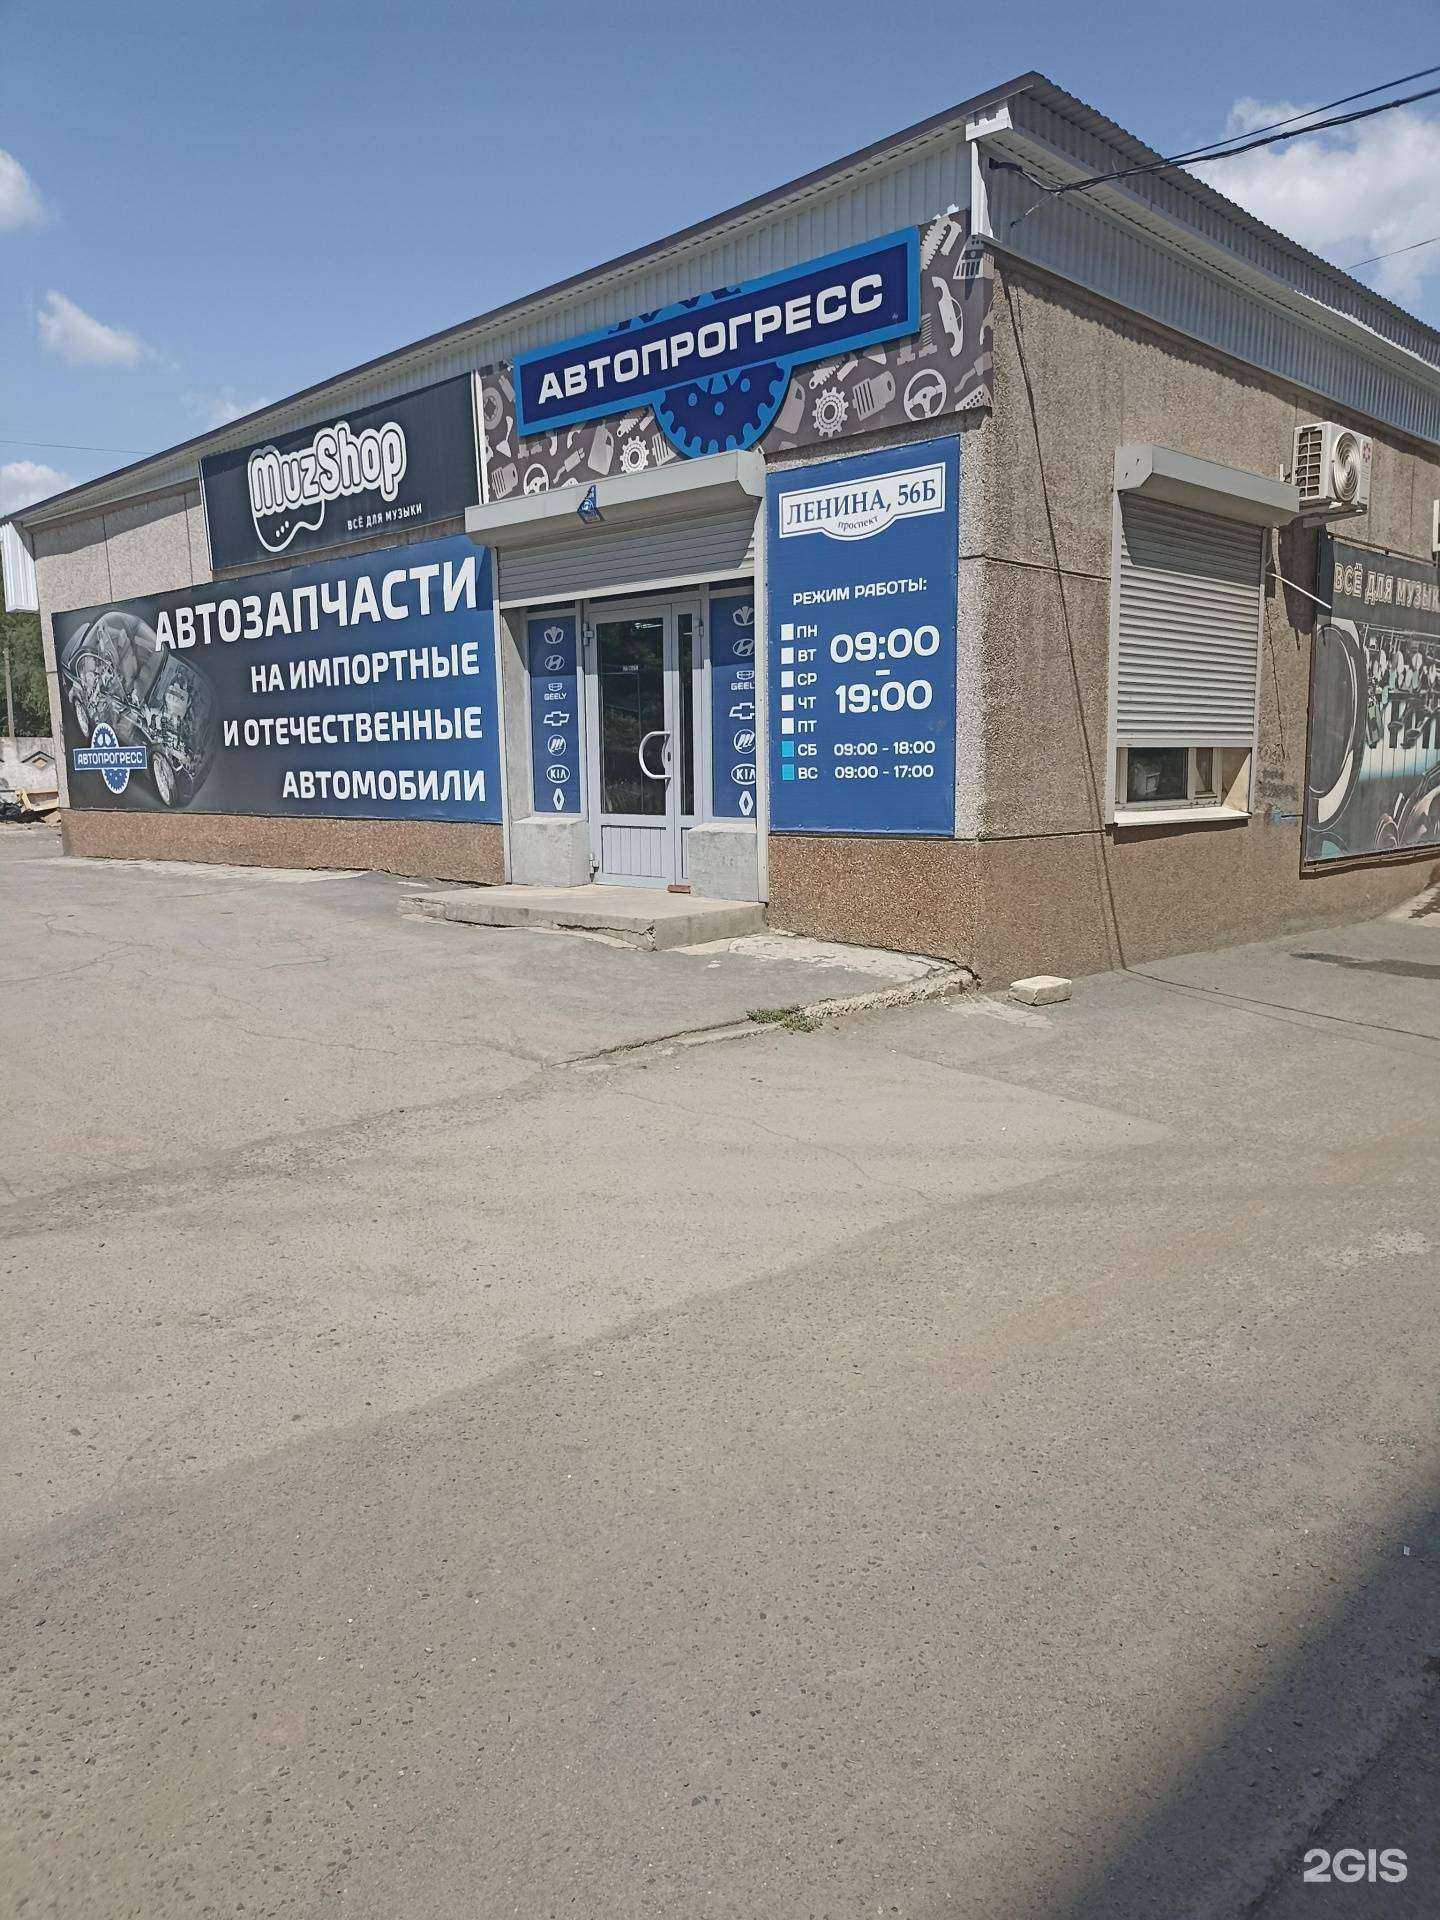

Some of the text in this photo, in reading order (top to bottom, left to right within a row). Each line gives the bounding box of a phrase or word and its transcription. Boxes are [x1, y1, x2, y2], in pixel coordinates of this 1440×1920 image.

[537, 273, 884, 405] АВТОПРОГРЕСС
[248, 420, 407, 518] MuzShop
[786, 478, 936, 526] ЛЕНИНА, 56Б
[347, 502, 422, 531] ВСЁ ДЛЯ МУЗЫКИ
[837, 515, 880, 533] проспект
[793, 577, 928, 606] РЕЖИМ РАБОТЫ:
[1333, 562, 1363, 598] ВСЁ
[1364, 570, 1394, 606] ДЛЯ
[155, 556, 477, 652] АВТОЗАПЧАСТИ
[796, 624, 818, 638] ПН
[797, 648, 817, 662] ВТ
[830, 625, 940, 664] 09:00
[251, 641, 481, 693] НА ИМПОРТНЫЕ
[730, 681, 755, 691] GEEL
[797, 672, 818, 686] СР
[544, 692, 567, 701] GEELY
[797, 696, 817, 710] ЧТ
[835, 679, 933, 714] 19:00
[224, 706, 484, 747] И ОТЕЧЕСТВЕННЫЕ
[797, 720, 818, 733] ПТ
[77, 751, 143, 765] АВТОПРОГРЕСС
[797, 743, 818, 757] СБ
[833, 742, 878, 756] 09:00
[893, 740, 936, 755] 18:00
[549, 769, 567, 779] KIA
[797, 766, 818, 780] ВС
[834, 765, 879, 779] 09:00
[893, 764, 934, 779] 17:00
[282, 770, 486, 801] АВТОМОБИЛИ
